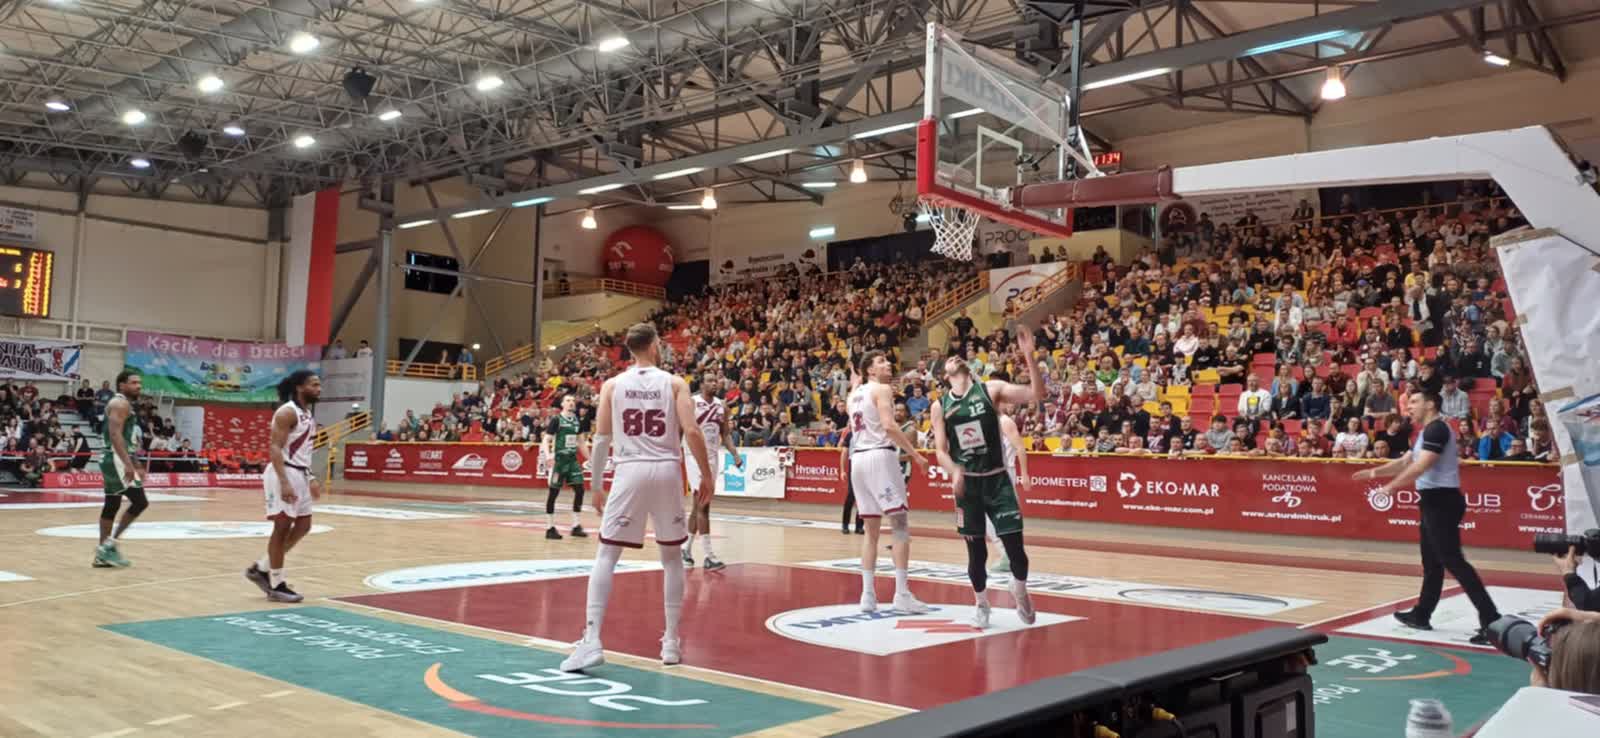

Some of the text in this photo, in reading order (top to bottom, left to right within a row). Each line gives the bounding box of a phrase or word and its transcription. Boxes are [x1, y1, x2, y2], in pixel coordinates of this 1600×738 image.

[211, 343, 241, 359] dla
[969, 402, 986, 417] 12
[622, 408, 666, 437] 86
[1016, 476, 1088, 488] RDIOMETER
[1262, 473, 1317, 484] KANCELARIA
[1262, 483, 1317, 493] PODATKOWA
